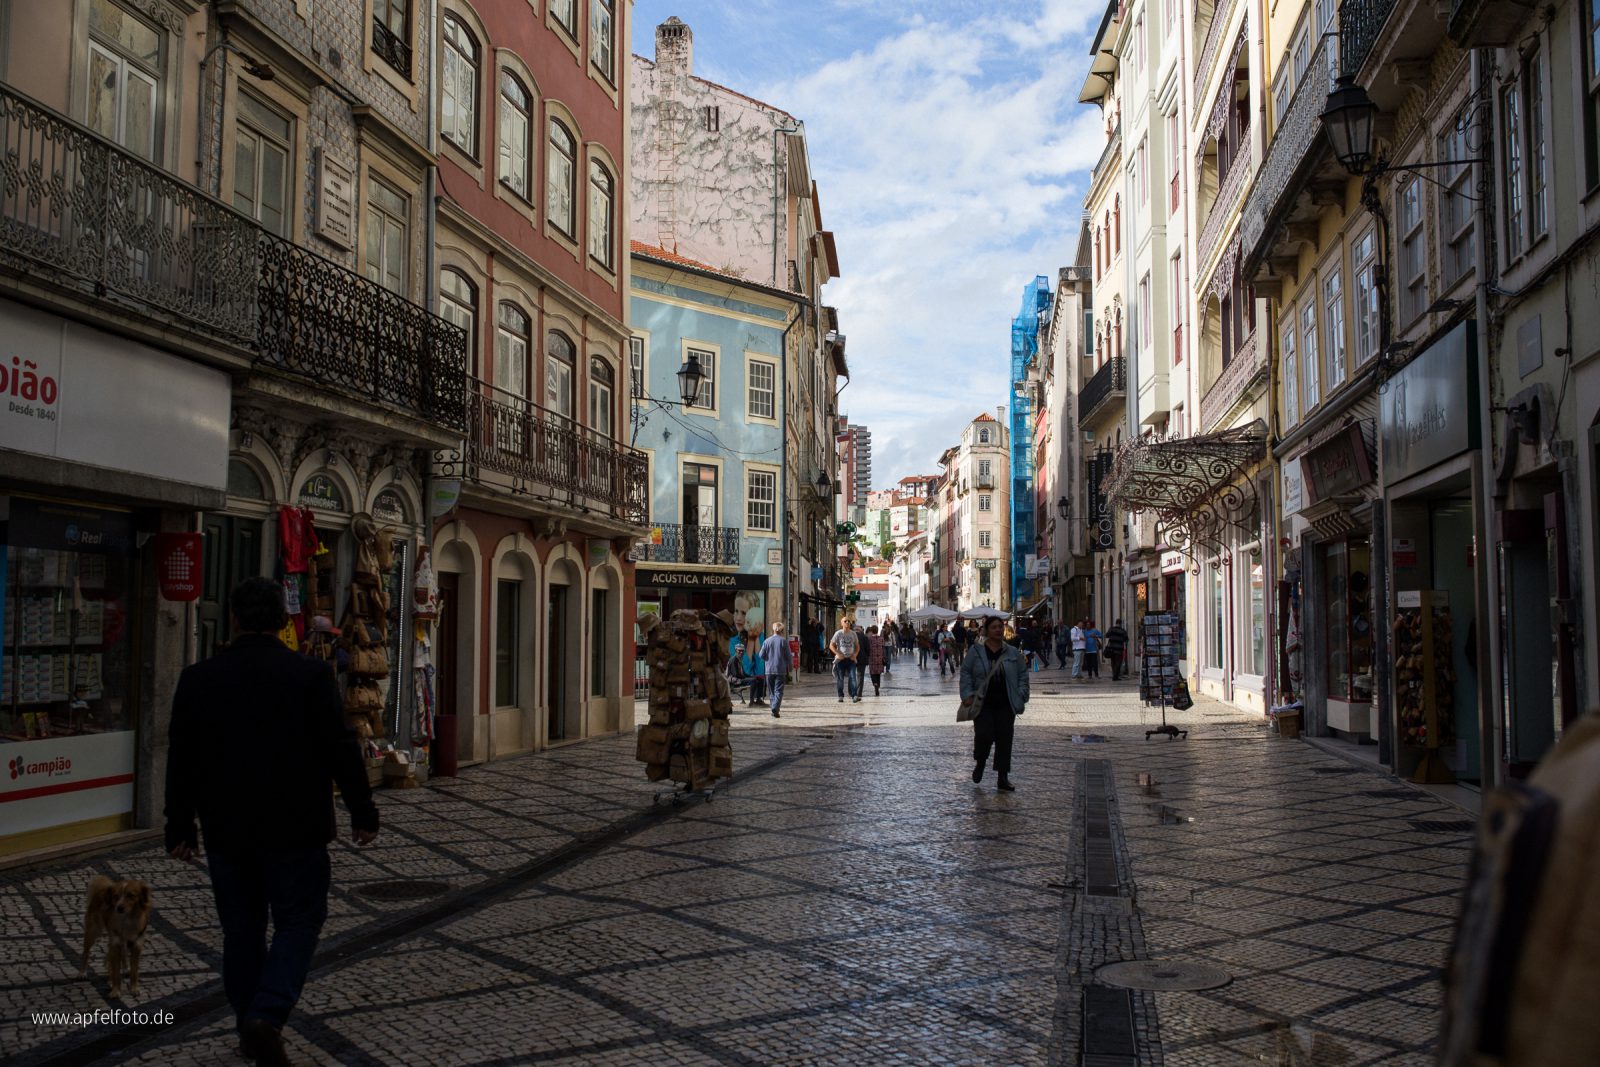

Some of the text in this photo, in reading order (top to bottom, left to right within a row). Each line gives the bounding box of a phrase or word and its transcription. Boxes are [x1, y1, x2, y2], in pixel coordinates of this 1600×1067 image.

[9, 401, 56, 422] Desde 1840
[651, 572, 737, 586] ACÚSTICA MÉDICA
[26, 757, 72, 777] campião
